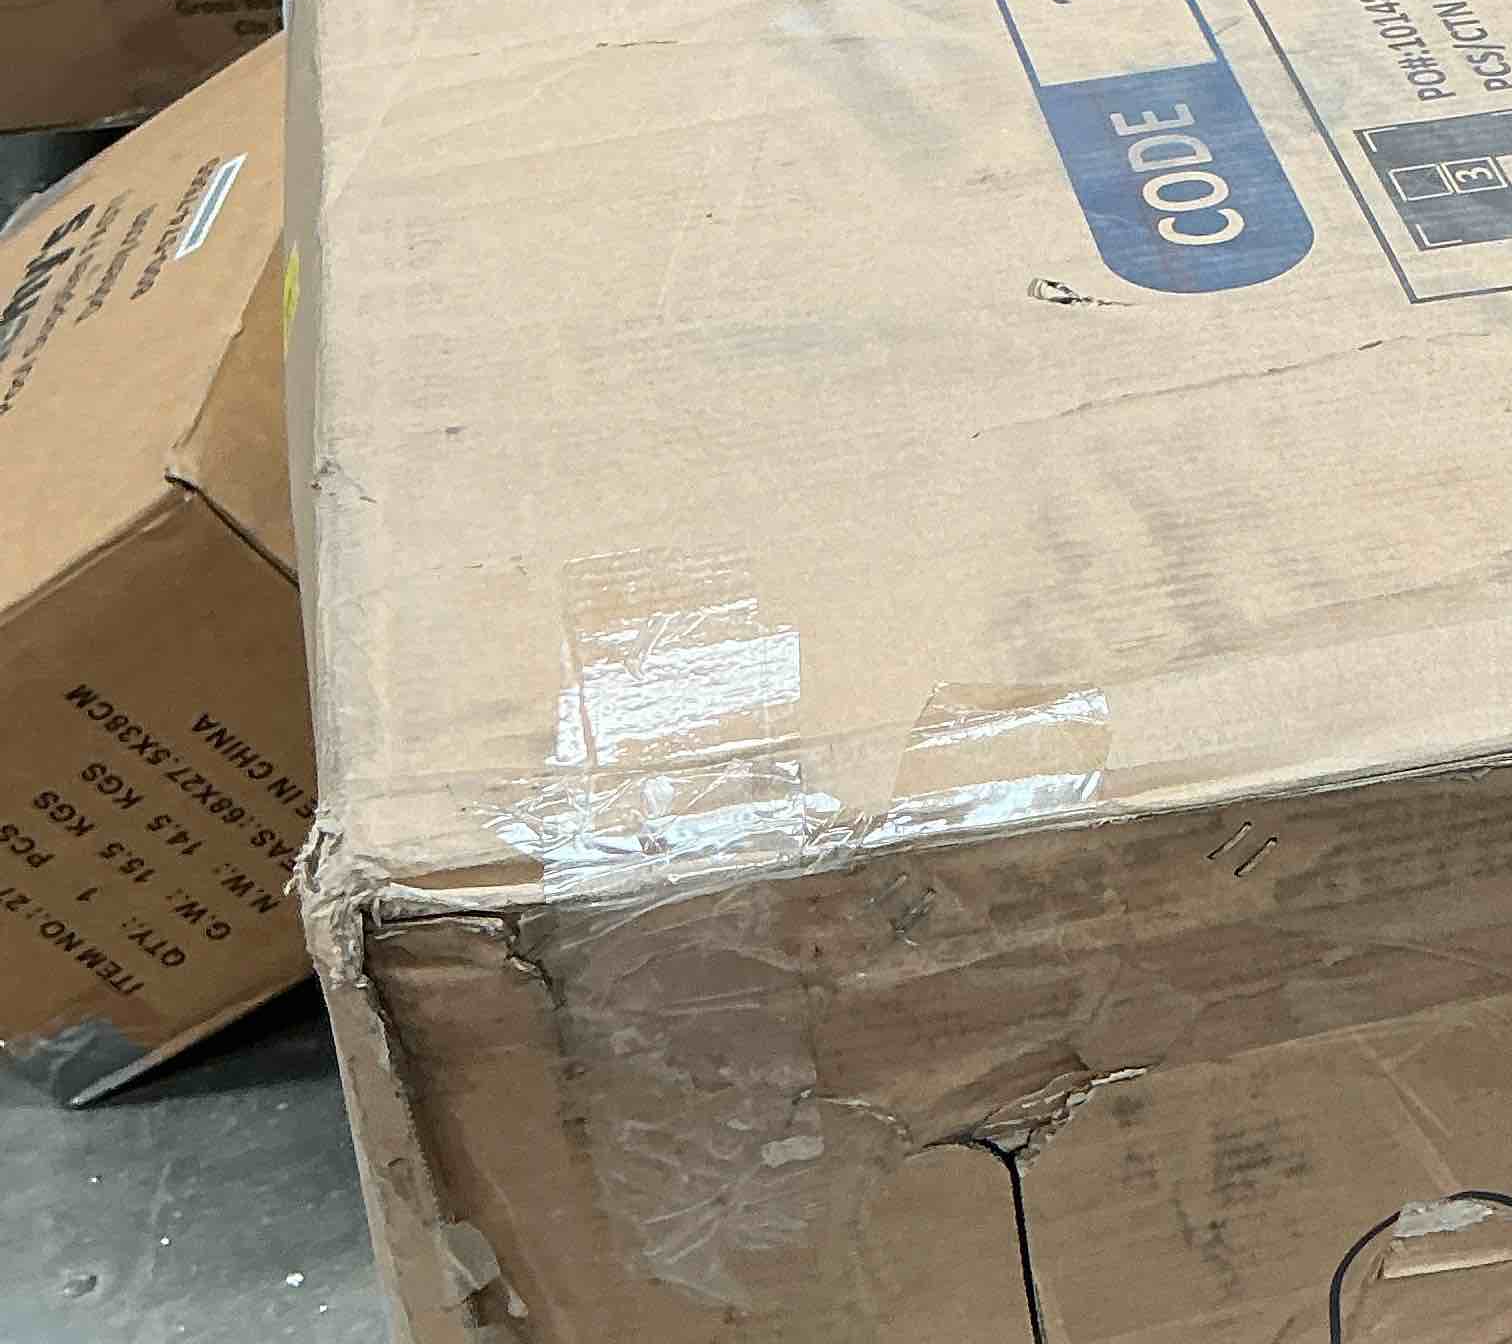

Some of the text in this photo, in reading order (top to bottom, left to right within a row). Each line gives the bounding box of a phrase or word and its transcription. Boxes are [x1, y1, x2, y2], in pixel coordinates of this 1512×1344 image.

[1109, 103, 1246, 248] CODE
[191, 712, 305, 806] IN CHINA
[81, 762, 145, 810] KGS
[33, 790, 97, 837] KGS
[147, 813, 205, 857] 14.5
[99, 841, 156, 884] 15.5
[74, 948, 145, 996] ITEM
